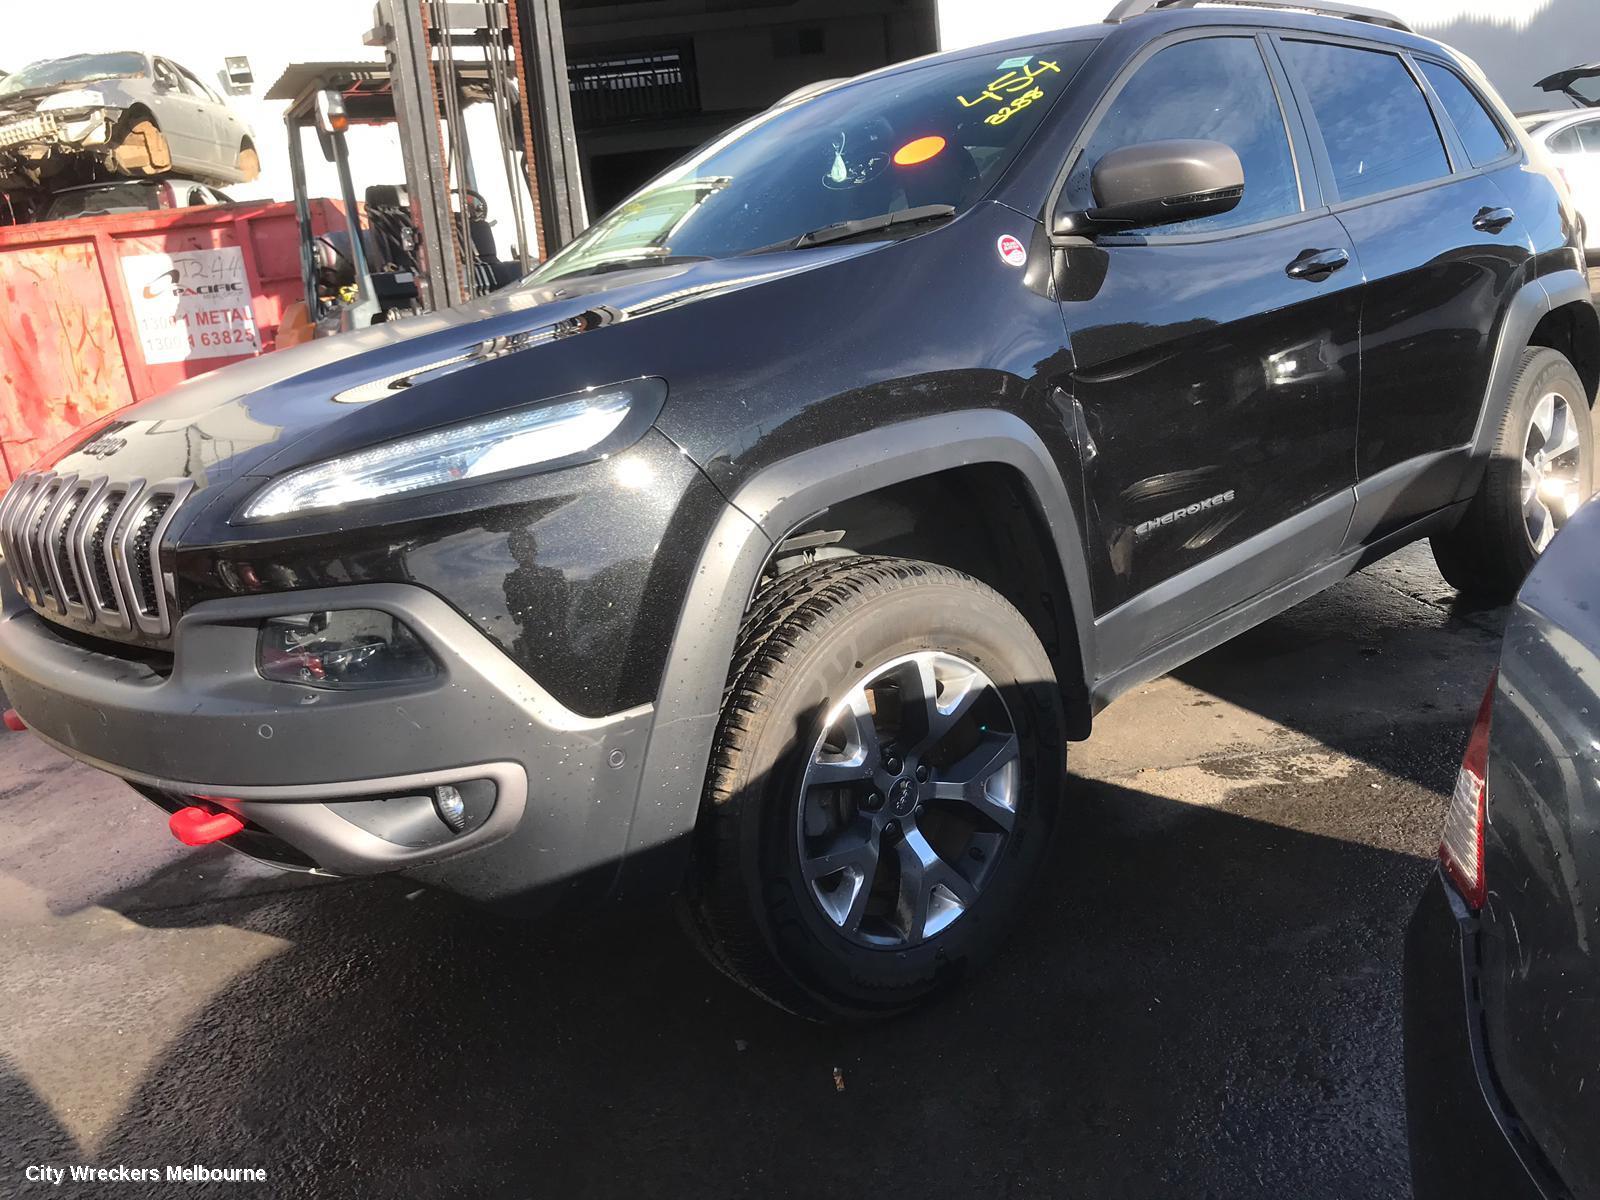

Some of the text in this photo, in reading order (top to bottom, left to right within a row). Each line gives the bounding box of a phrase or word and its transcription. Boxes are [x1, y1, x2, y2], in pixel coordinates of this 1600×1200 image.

[956, 60, 1061, 107] 454
[172, 282, 243, 297] PACIFIC
[200, 328, 255, 346] 63825
[1135, 489, 1235, 535] CHEROKEE
